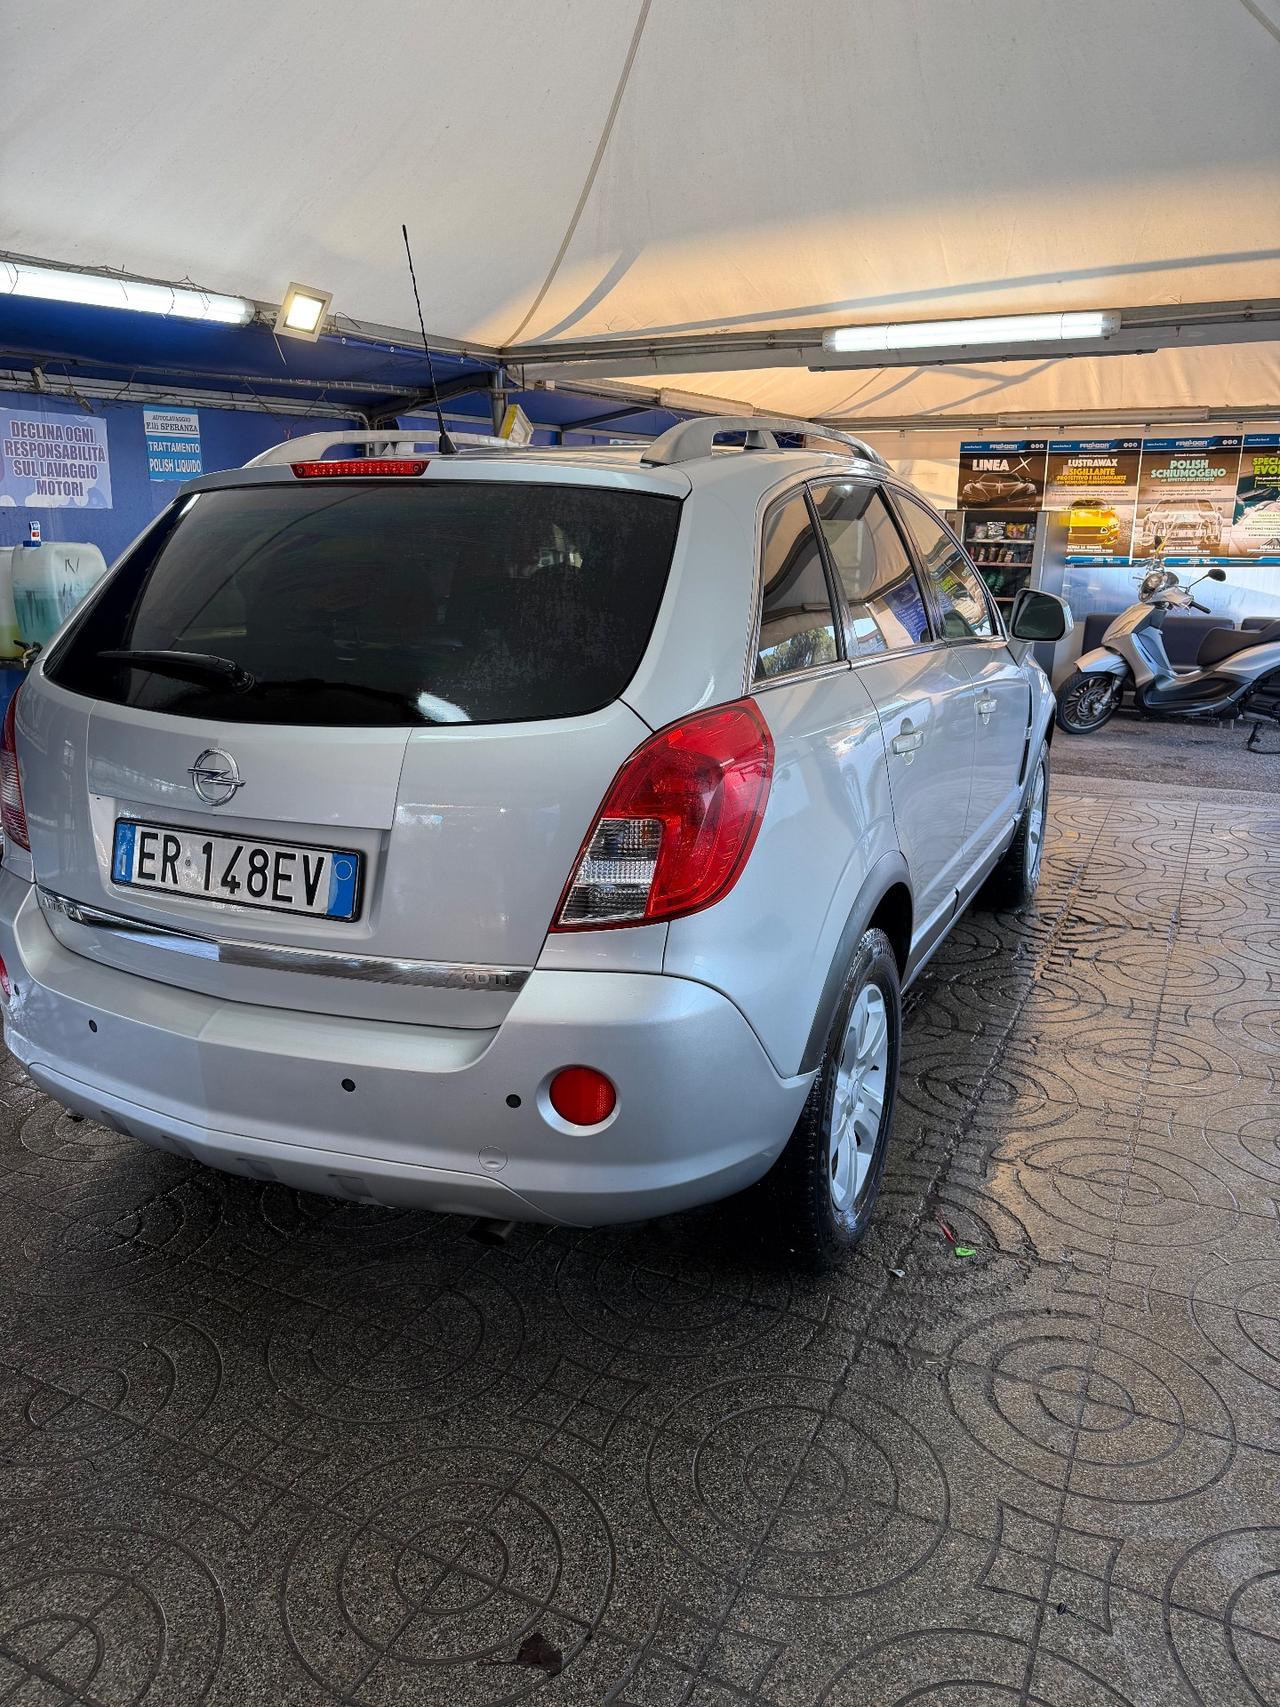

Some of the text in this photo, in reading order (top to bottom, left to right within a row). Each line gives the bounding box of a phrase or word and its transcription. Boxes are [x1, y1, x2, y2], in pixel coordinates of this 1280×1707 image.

[11, 421, 95, 443] DECLINA OGNI
[160, 423, 198, 432] SPERANZA
[4, 439, 106, 462] RESPONSABILITÀ
[148, 442, 200, 453] TRATTAMENTO
[149, 459, 202, 473] POLISH LIQUIDO
[972, 459, 1010, 471] LINEA
[1067, 458, 1118, 467] LUSTRAWAX
[1170, 459, 1209, 469] POLISH
[13, 460, 98, 479] SUL LAVAGGIO
[1068, 468, 1116, 476] SIGILLANTE
[1150, 468, 1227, 478] SCHIUMOGENO
[36, 480, 84, 496] MOTORI
[137, 831, 326, 907] ER 148EV
